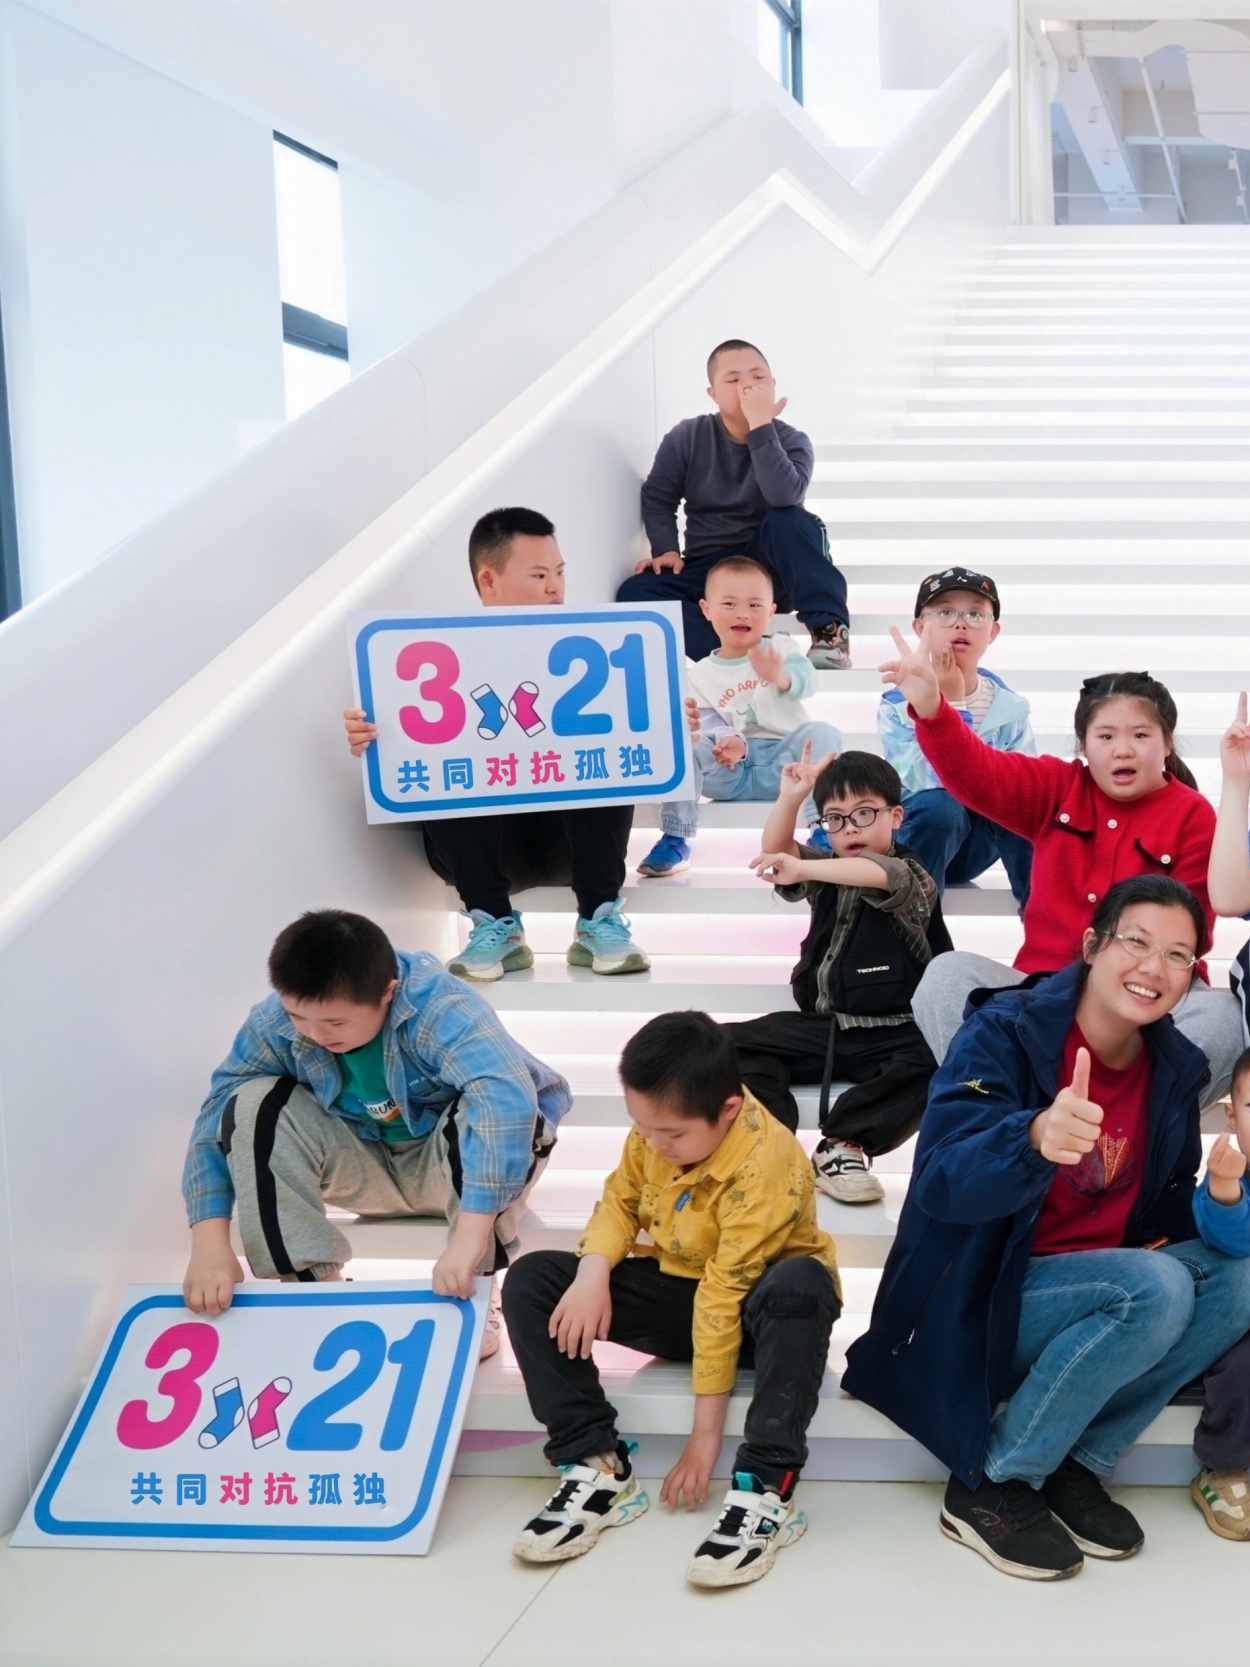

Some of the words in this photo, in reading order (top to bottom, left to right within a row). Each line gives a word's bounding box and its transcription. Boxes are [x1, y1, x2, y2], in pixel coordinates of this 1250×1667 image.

[396, 640, 467, 745] 3
[547, 632, 652, 738] 21
[396, 743, 654, 794] 共同对抗孤独
[116, 1321, 220, 1451] 3
[285, 1318, 437, 1452] 21
[129, 1471, 387, 1507] 共同对抗孤独
